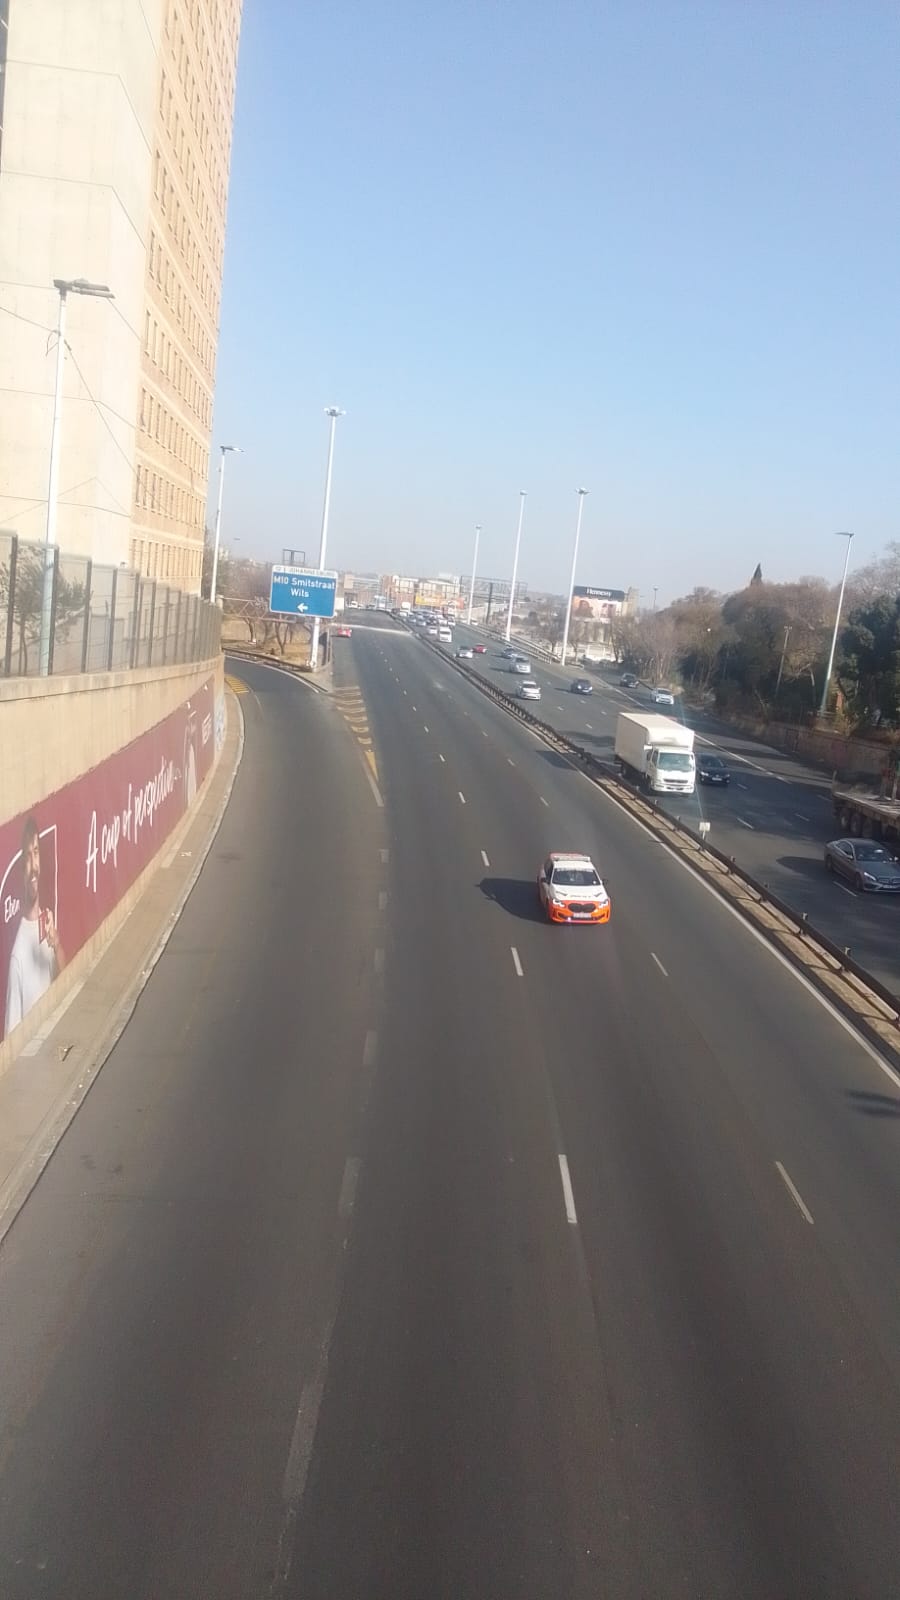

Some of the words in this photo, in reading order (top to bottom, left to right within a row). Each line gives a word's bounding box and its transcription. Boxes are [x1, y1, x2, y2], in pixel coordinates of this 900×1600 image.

[274, 576, 289, 585] M10
[291, 577, 335, 589] Smitstraat
[290, 588, 309, 598] Wits
[86, 810, 99, 892] A
[101, 815, 120, 868] cup
[123, 783, 132, 841] of
